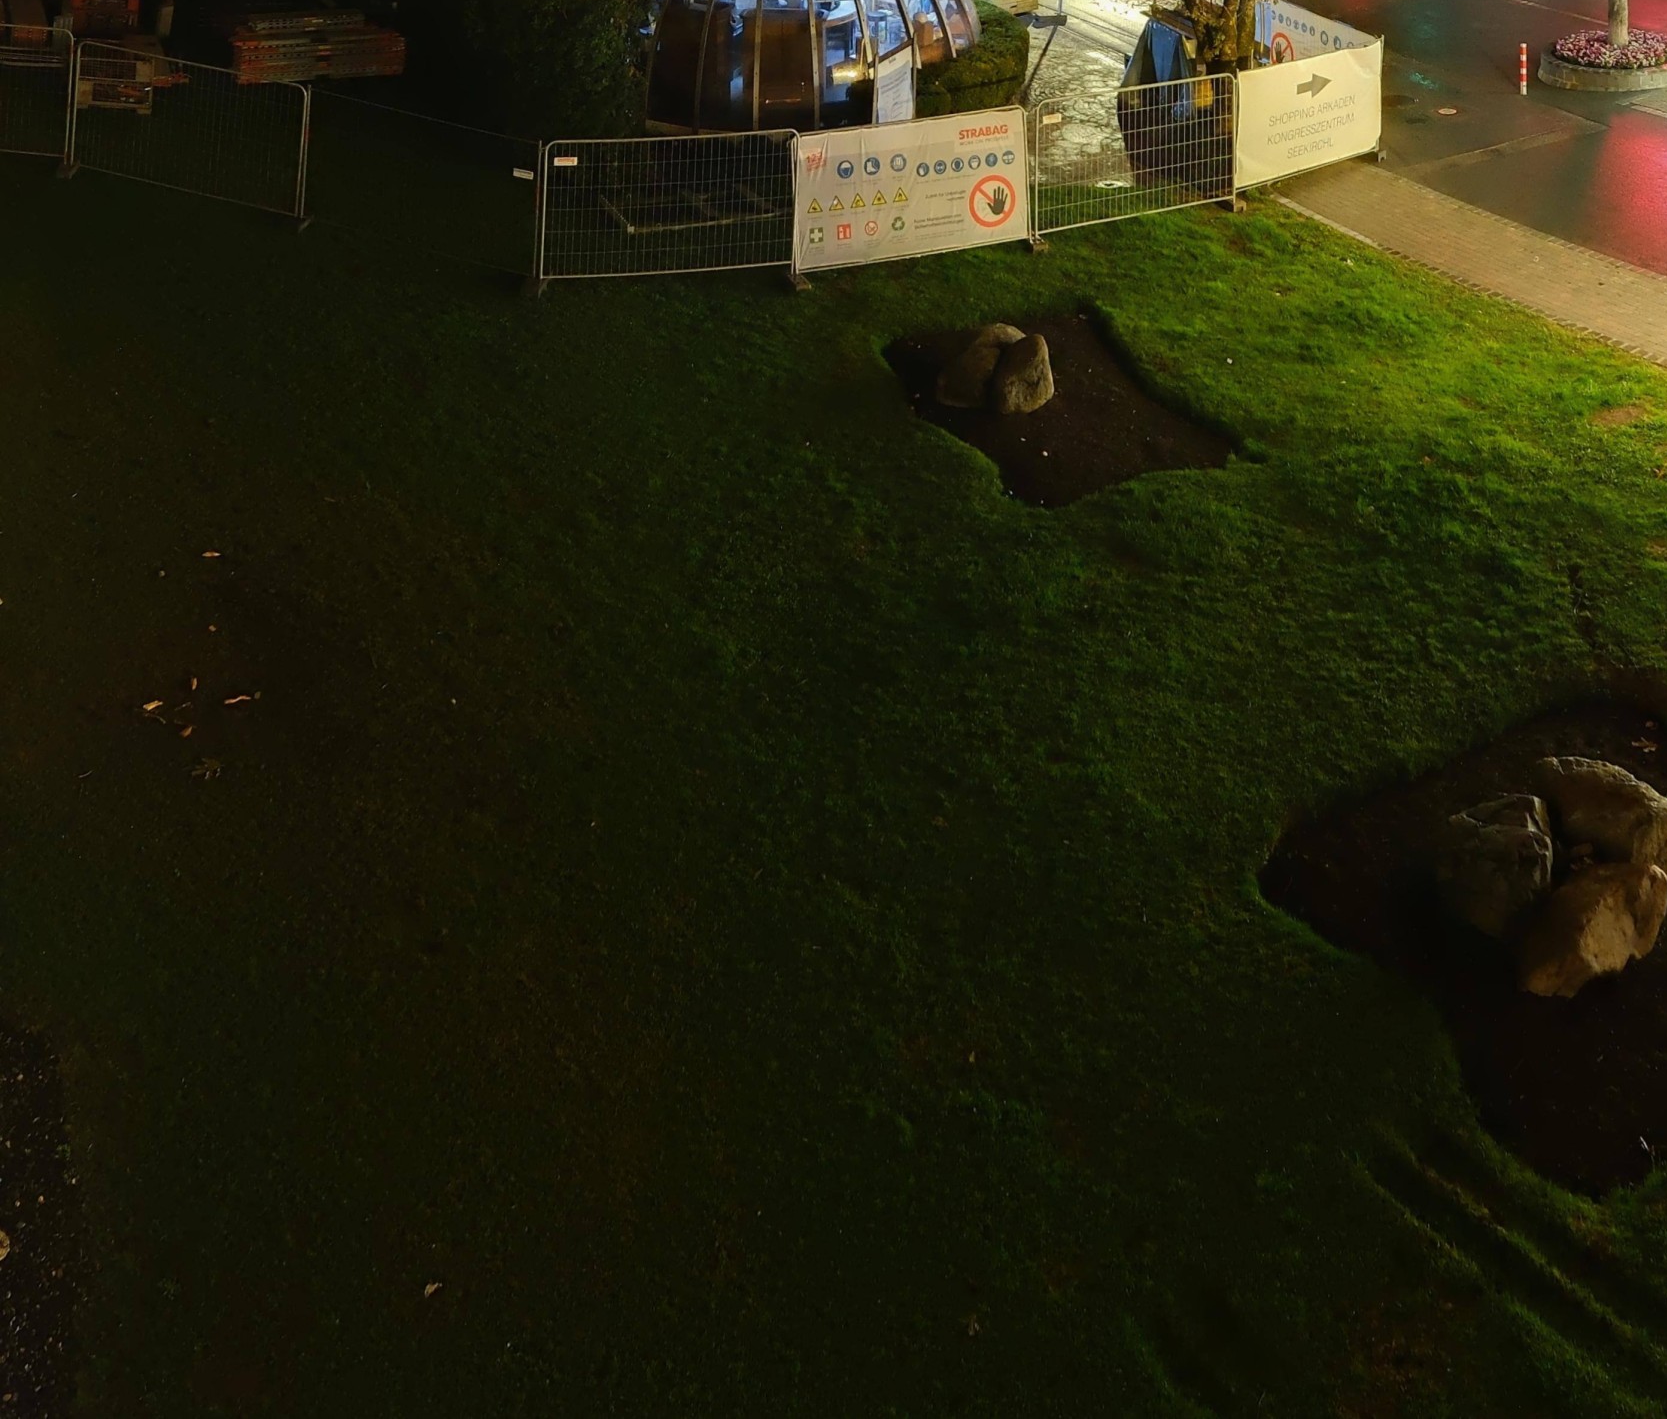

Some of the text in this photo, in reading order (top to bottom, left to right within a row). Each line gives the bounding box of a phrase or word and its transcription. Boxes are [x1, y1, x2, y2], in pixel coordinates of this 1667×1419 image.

[1268, 94, 1356, 127] SHOPPING ARKADEN
[959, 124, 1008, 140] STRABAG
[1267, 112, 1355, 145] KONGRESSZENTRUM
[1287, 137, 1334, 160] SEEKIRCHL
